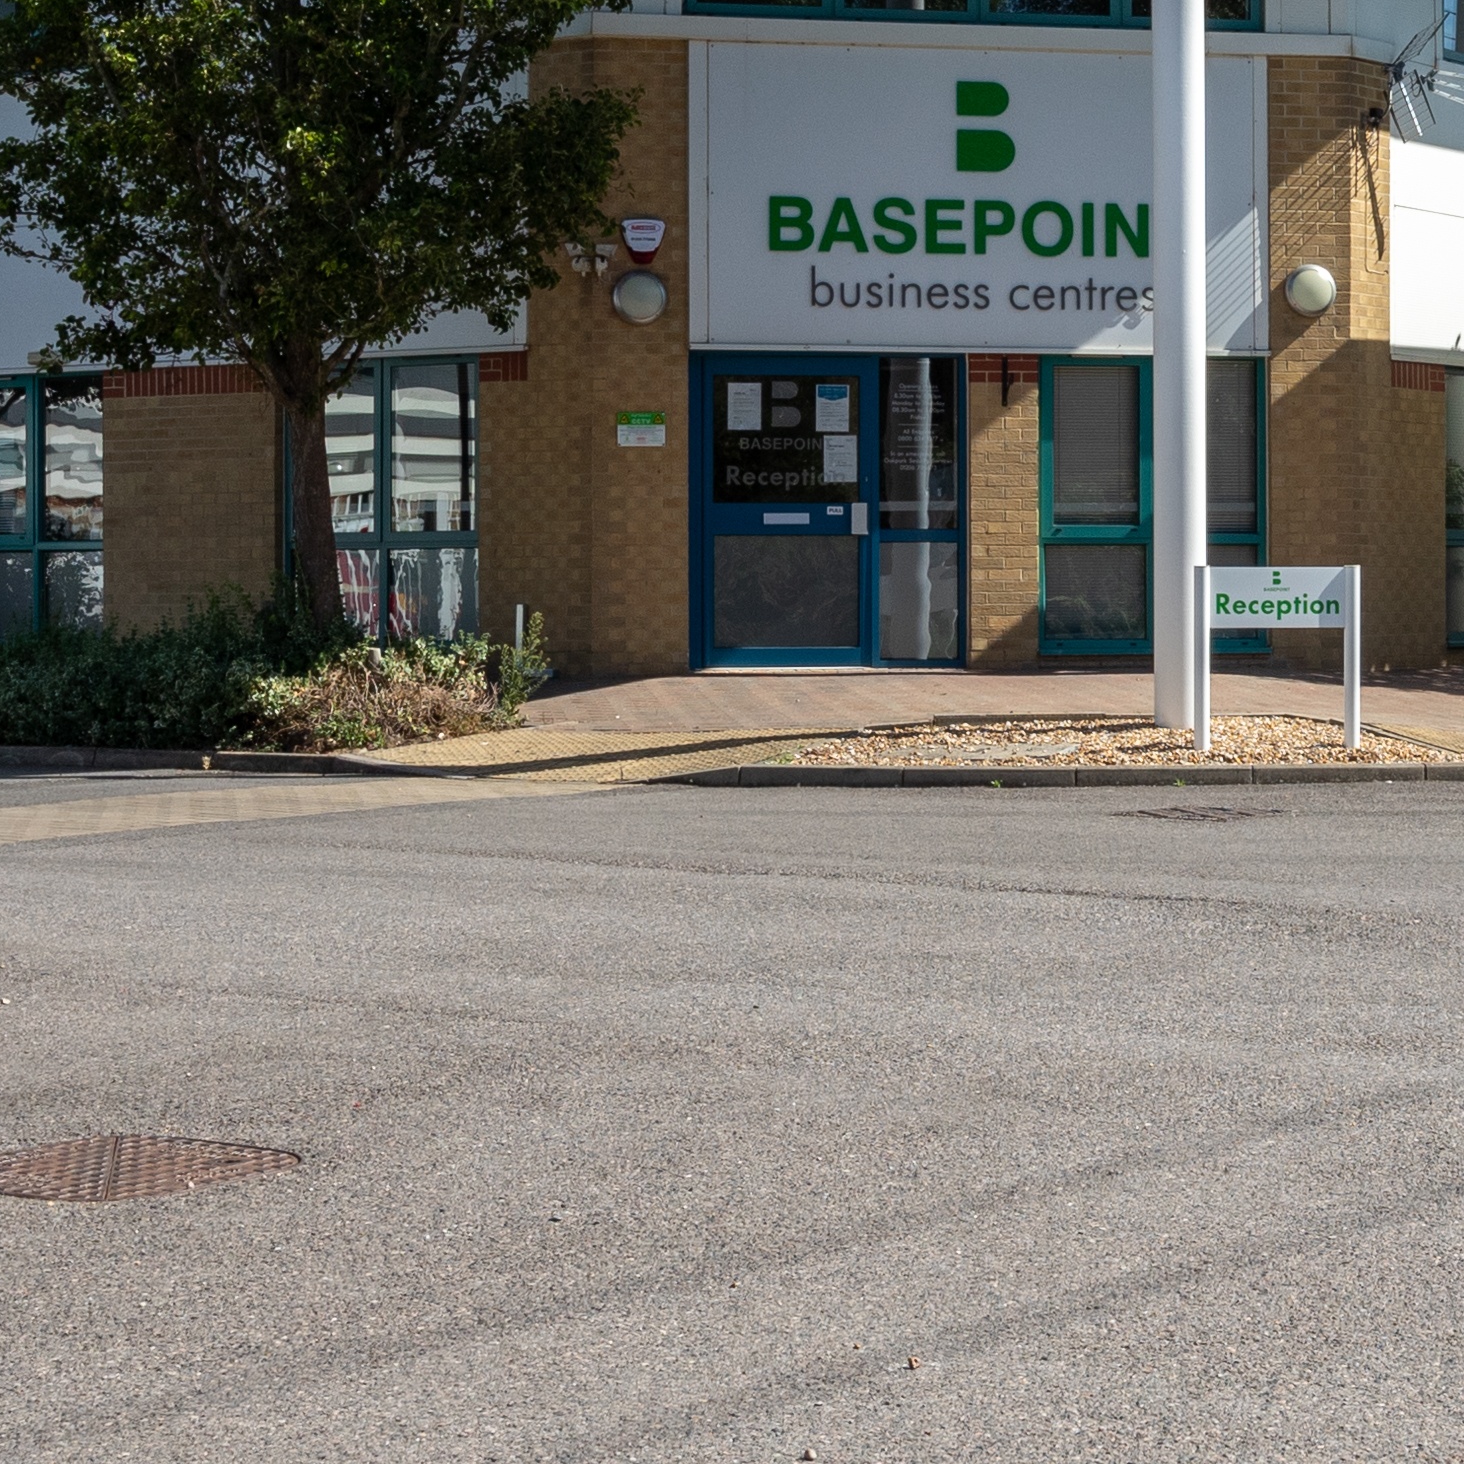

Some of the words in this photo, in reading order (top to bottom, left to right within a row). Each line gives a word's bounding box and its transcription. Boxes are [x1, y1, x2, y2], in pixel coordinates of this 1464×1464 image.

[768, 195, 1150, 258] BASEPOIN
[810, 265, 991, 309] business
[1009, 277, 1154, 312] centres
[740, 437, 823, 451] BASEPOIN
[1216, 593, 1340, 620] Reception
